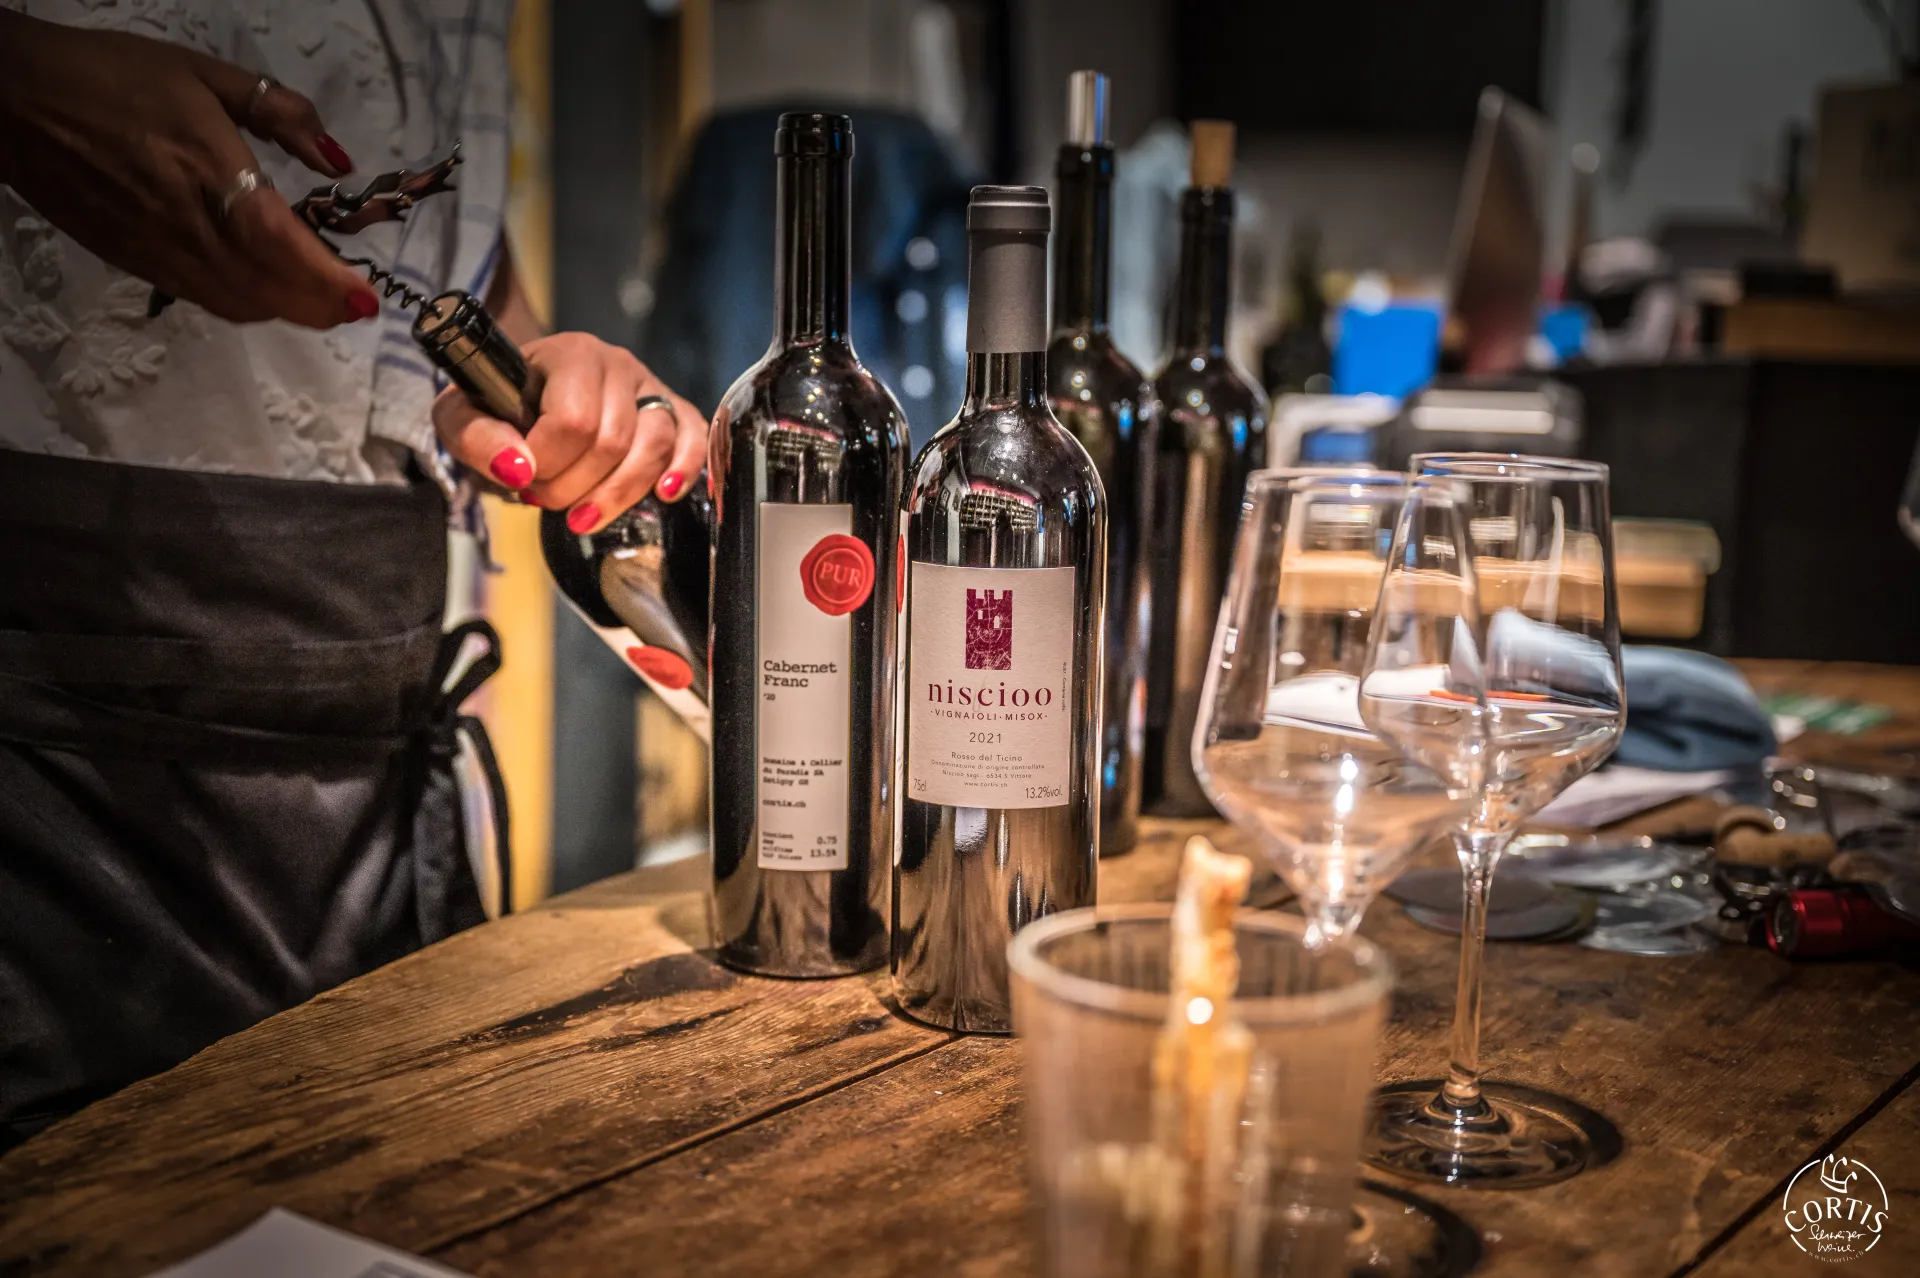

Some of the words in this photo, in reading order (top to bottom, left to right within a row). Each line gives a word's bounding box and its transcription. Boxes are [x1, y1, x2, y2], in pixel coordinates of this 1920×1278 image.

[820, 561, 861, 588] PUR
[763, 660, 837, 673] Cabernet
[763, 674, 809, 687] Franc
[928, 678, 1052, 706] niscioo
[969, 732, 1002, 743] 2021
[951, 751, 976, 761] Rosso
[931, 759, 976, 769] Denominazione
[986, 764, 1009, 772] origine
[913, 778, 927, 792] 75cl
[817, 836, 837, 845] 0.75
